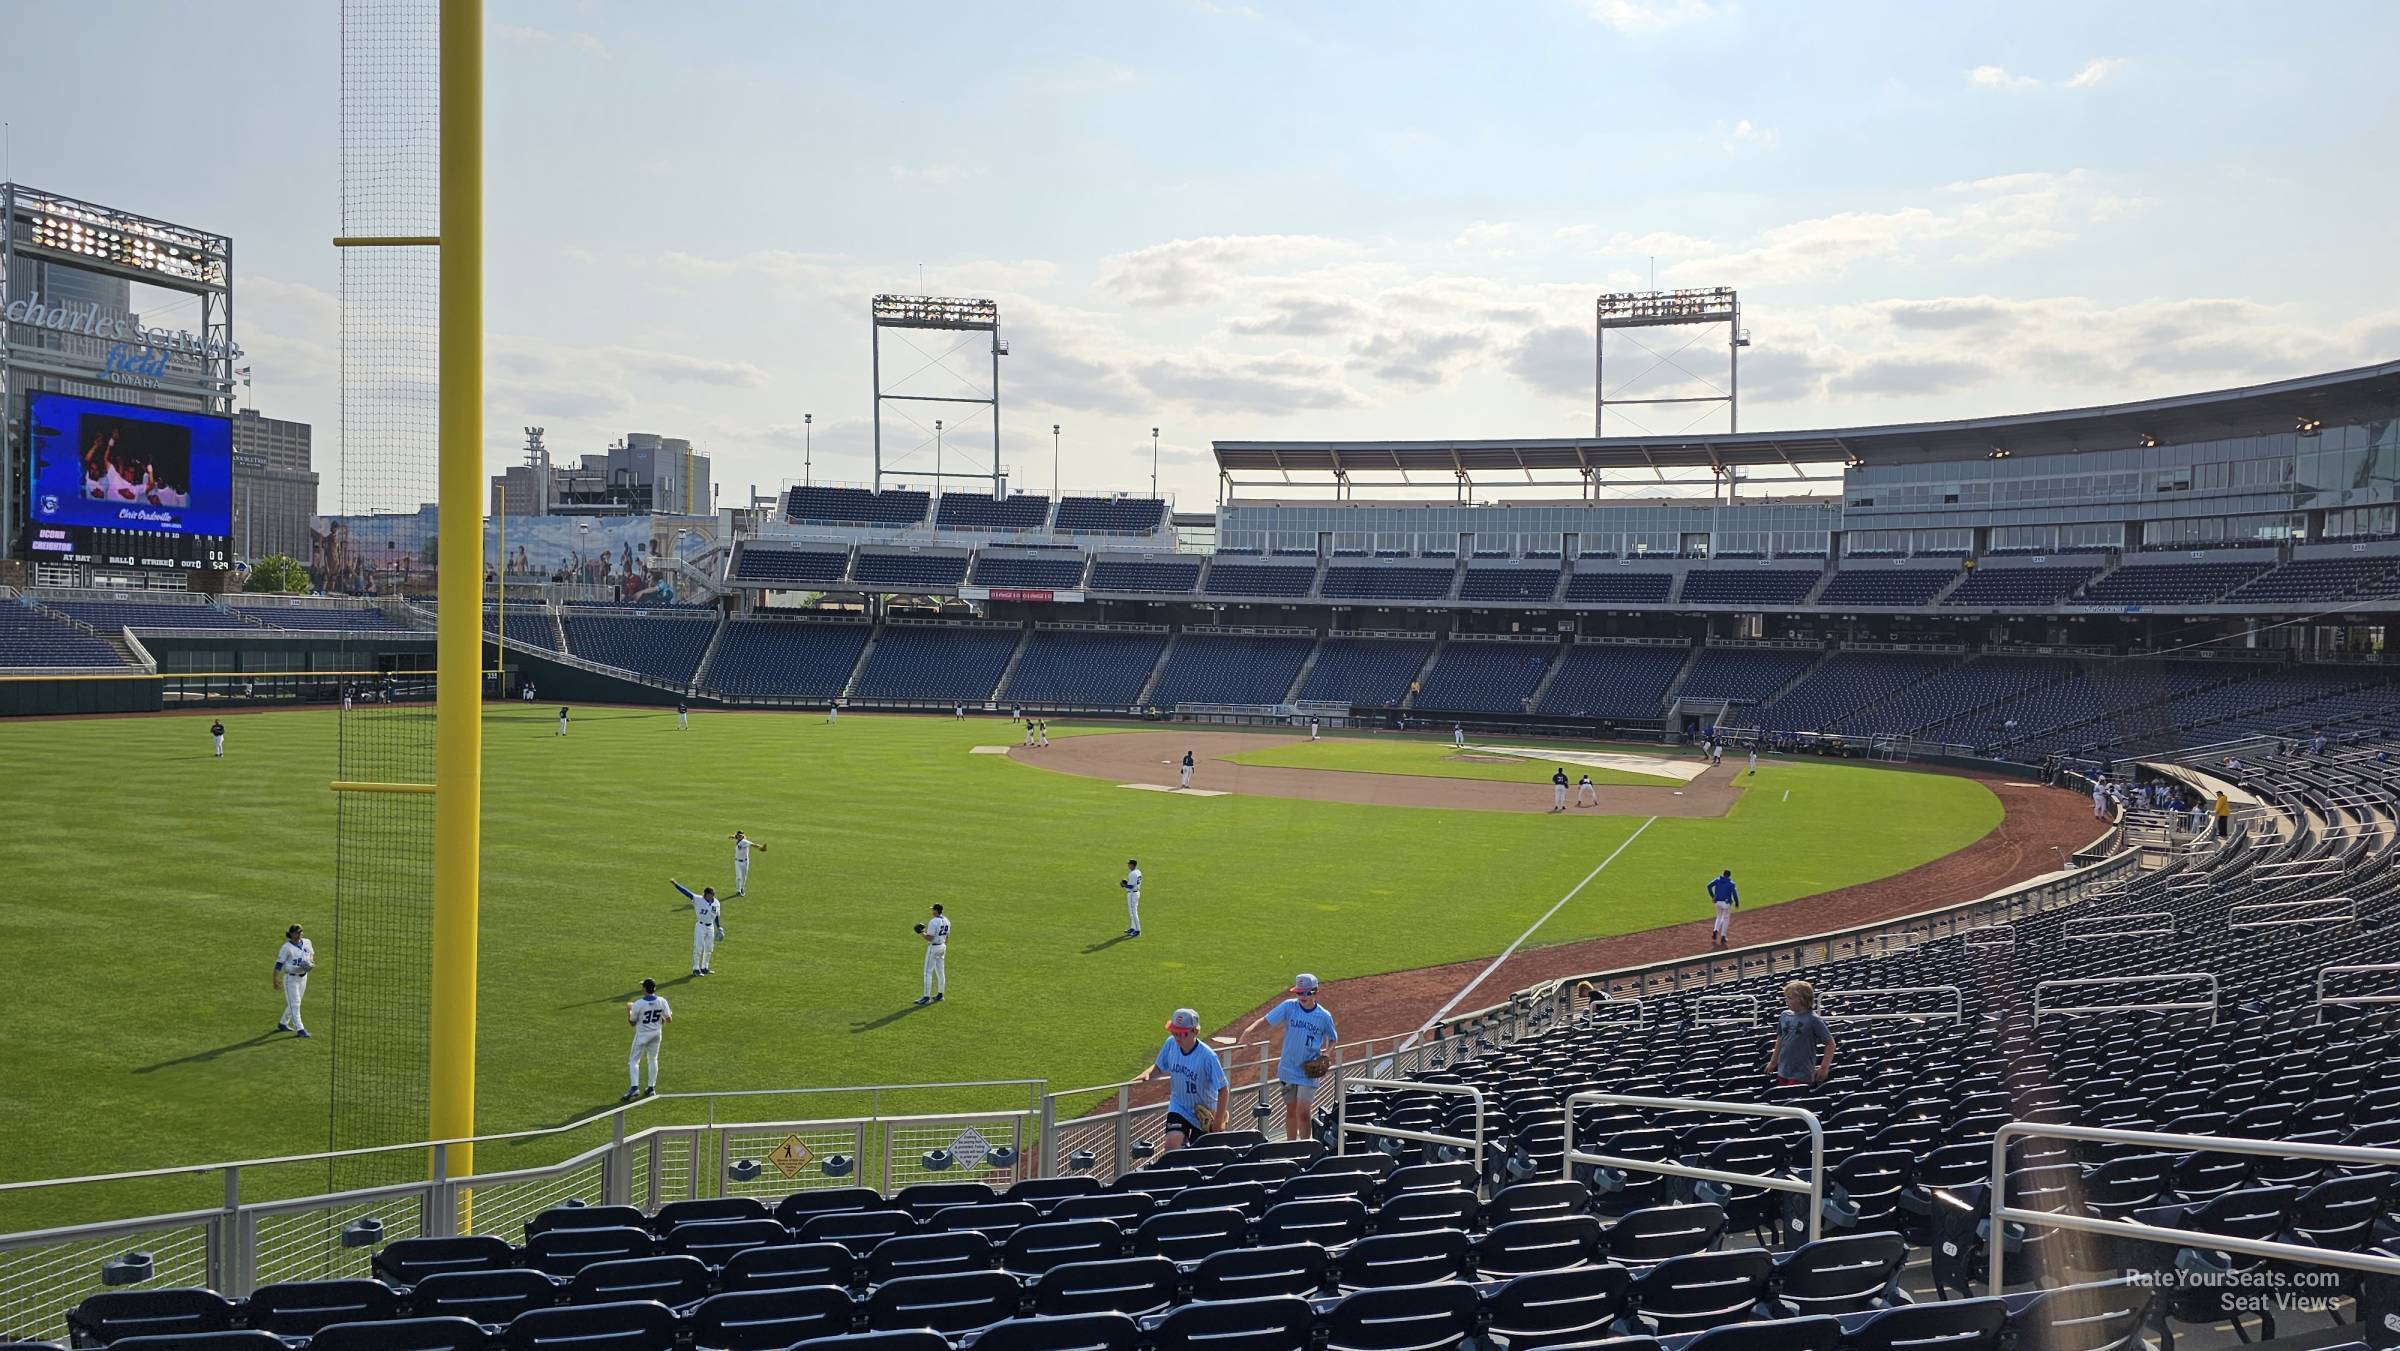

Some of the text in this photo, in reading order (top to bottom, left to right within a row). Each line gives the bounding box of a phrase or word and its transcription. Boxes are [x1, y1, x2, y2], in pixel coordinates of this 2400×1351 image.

[6, 291, 242, 361] charles SCHWAB
[111, 372, 161, 389] OMAHA
[39, 529, 65, 540] UCONN
[32, 541, 73, 551] CREIGHTON
[109, 556, 128, 565] BALL
[141, 558, 169, 566] STRIKE
[181, 560, 195, 568] OUT
[642, 1009, 663, 1025] 35
[1793, 1219, 1802, 1229] 20
[1945, 1244, 1955, 1255] 21
